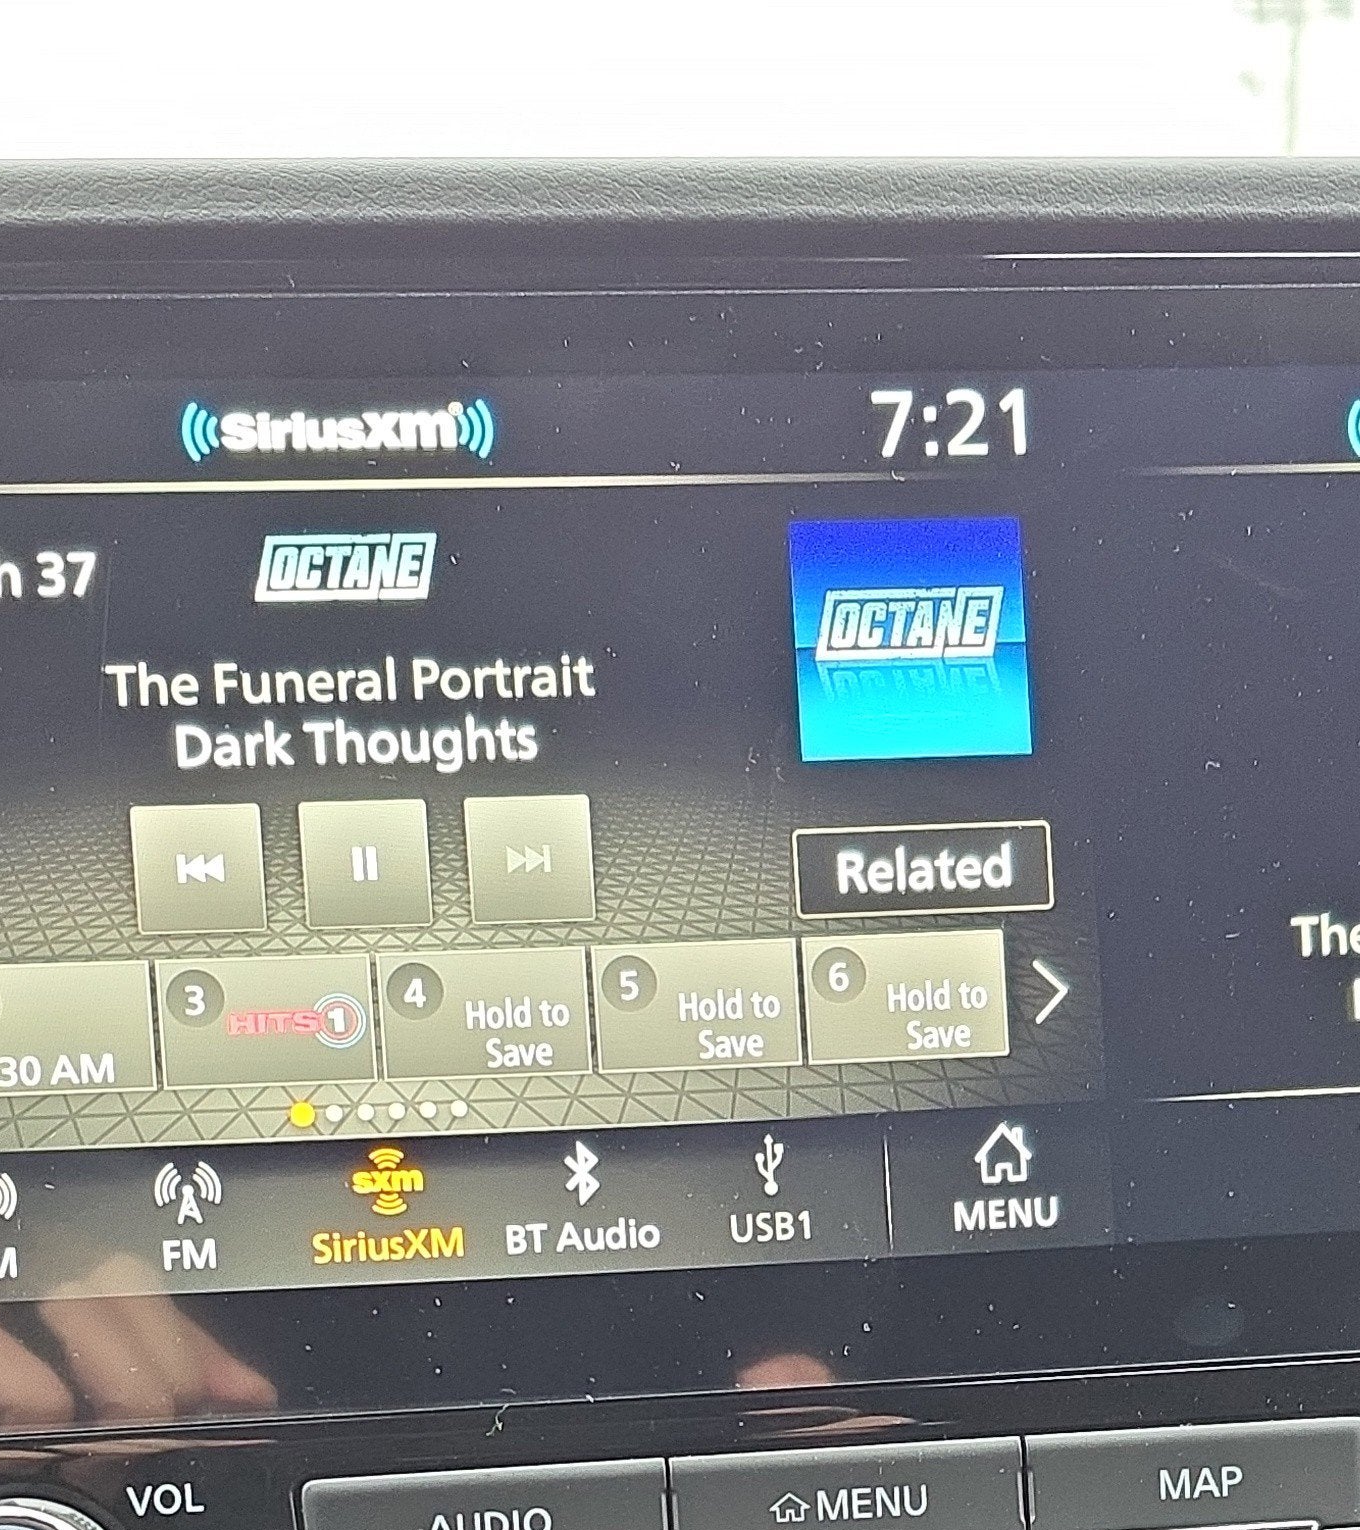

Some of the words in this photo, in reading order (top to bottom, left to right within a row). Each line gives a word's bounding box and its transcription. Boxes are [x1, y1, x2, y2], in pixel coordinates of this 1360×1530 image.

[871, 389, 1029, 458] 7:21
[37, 551, 96, 598] 37
[266, 541, 428, 593] OCTANE
[826, 597, 996, 652] OCTANE
[106, 662, 198, 706] The
[216, 658, 396, 704] Funeral
[414, 654, 594, 701] Portrait
[176, 722, 293, 769] Dark
[305, 717, 538, 772] Thoughts
[838, 843, 1012, 894] Related
[403, 979, 427, 1007] 4
[620, 971, 639, 1000] 5
[829, 963, 849, 991] 6
[184, 986, 205, 1015] 3
[678, 989, 751, 1022] Hold
[755, 991, 781, 1019] to
[888, 981, 958, 1013] Hold
[963, 982, 988, 1010] to
[228, 1011, 321, 1035] HITS
[466, 997, 540, 1031] Hold
[545, 998, 570, 1027] to
[698, 1029, 764, 1059] Save
[908, 1020, 971, 1050] Save
[51, 1054, 115, 1085] AM
[485, 1038, 553, 1068] Save
[731, 1211, 812, 1243] USB1
[954, 1197, 1058, 1232] MENU
[313, 1228, 464, 1264] SiriusXM
[507, 1223, 547, 1254] BT
[557, 1219, 659, 1252] Audio
[162, 1239, 217, 1271] FM
[1159, 1466, 1243, 1500] MAP
[127, 1484, 205, 1516] VOL
[817, 1484, 928, 1520] MENU
